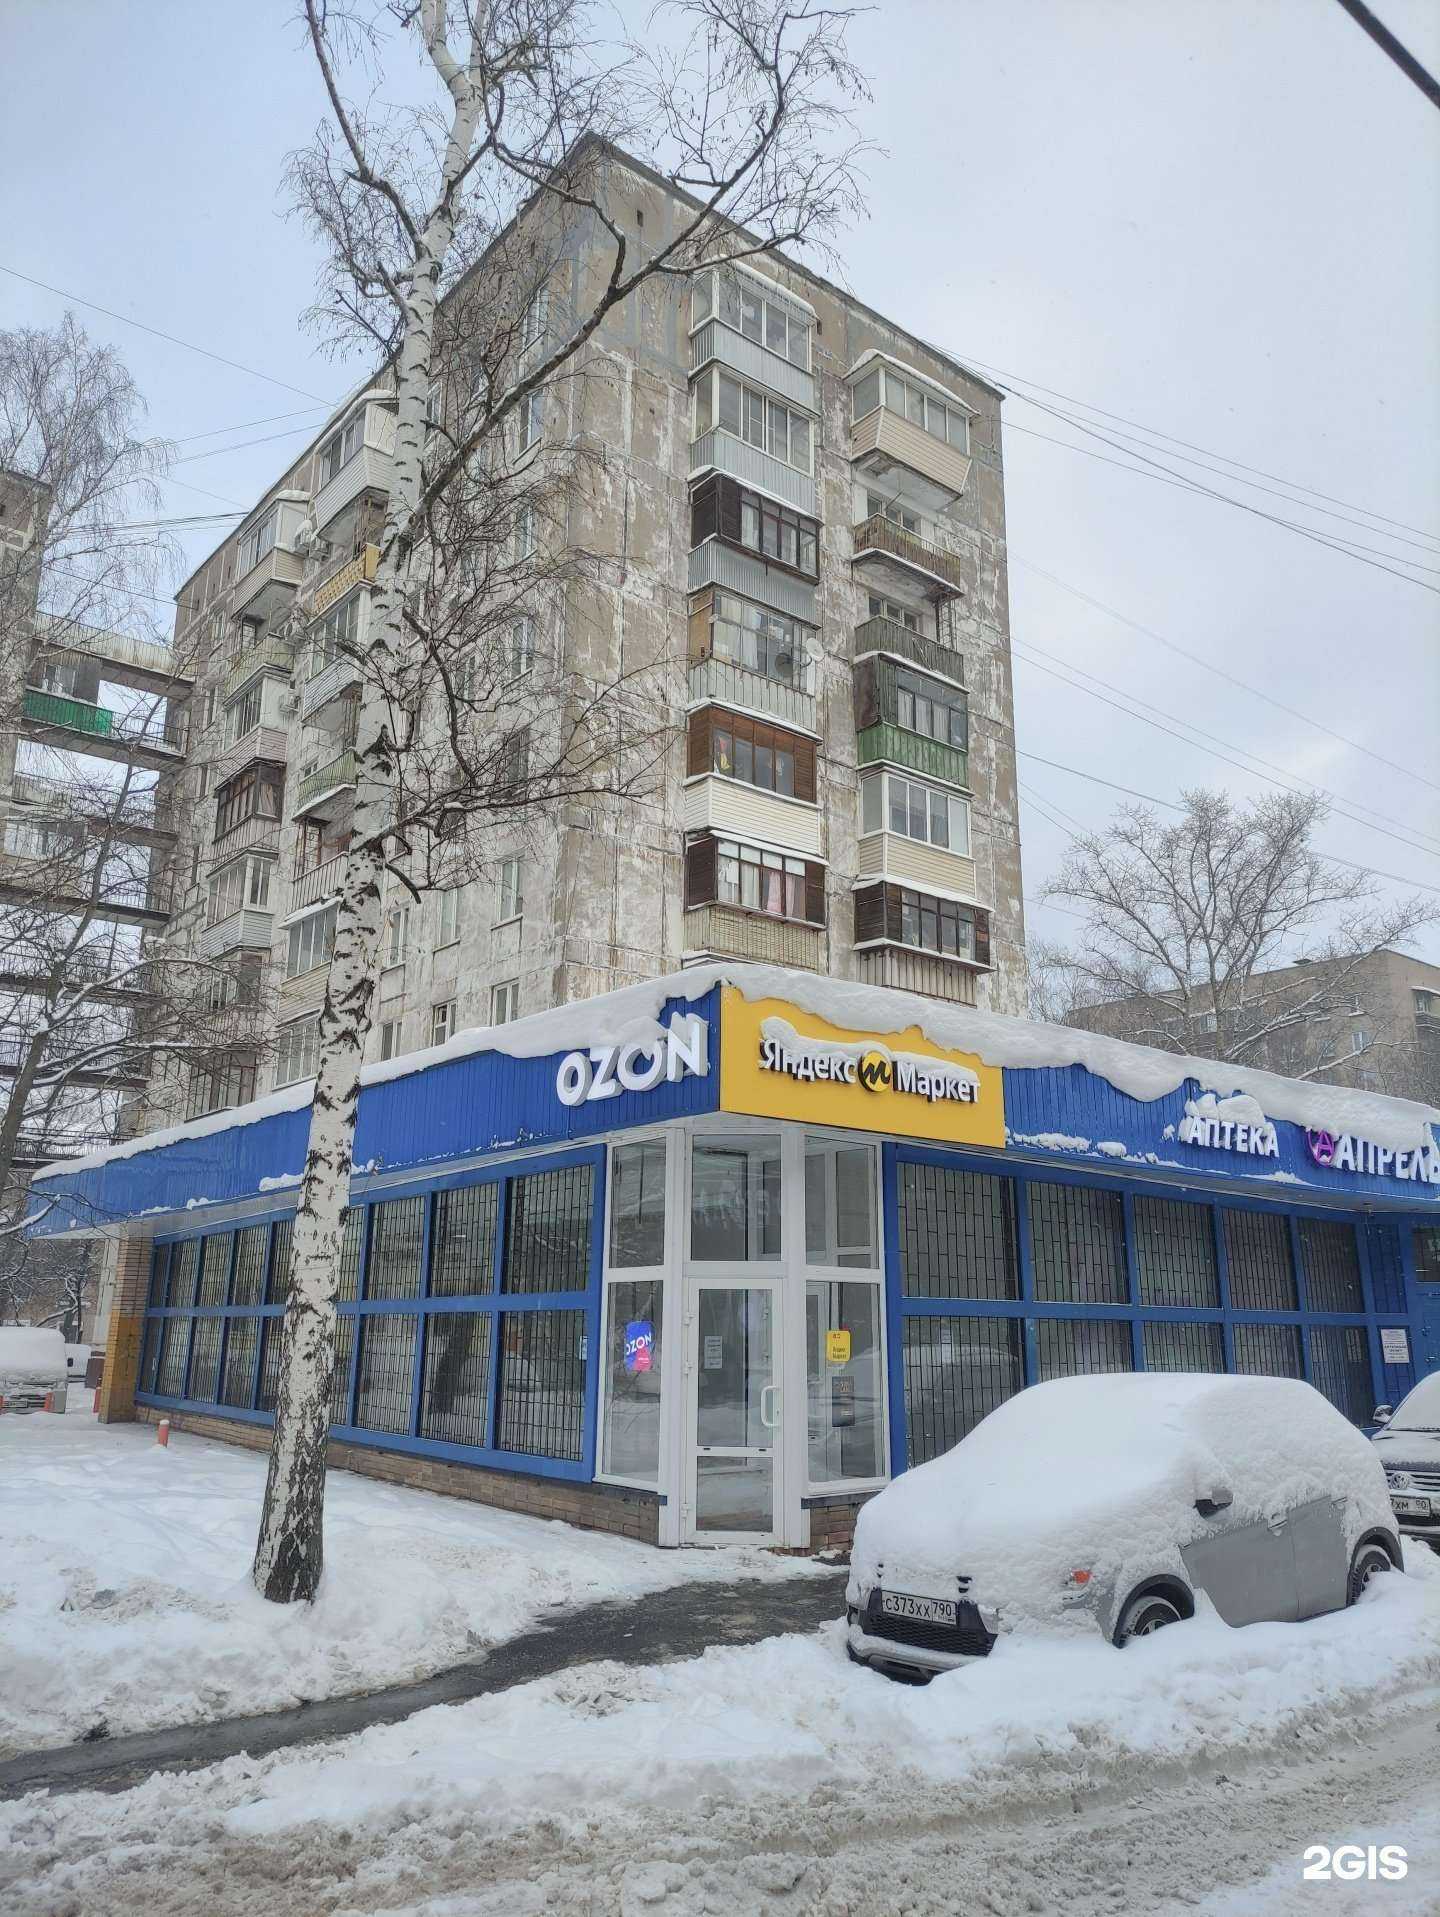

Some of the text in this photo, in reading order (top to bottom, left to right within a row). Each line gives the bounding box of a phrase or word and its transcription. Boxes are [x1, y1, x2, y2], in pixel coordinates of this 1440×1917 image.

[556, 1013, 709, 1107] OZON
[760, 1039, 857, 1084] Яндекс
[893, 1059, 980, 1104] Маркет
[1179, 1115, 1280, 1158] АПТЕКА
